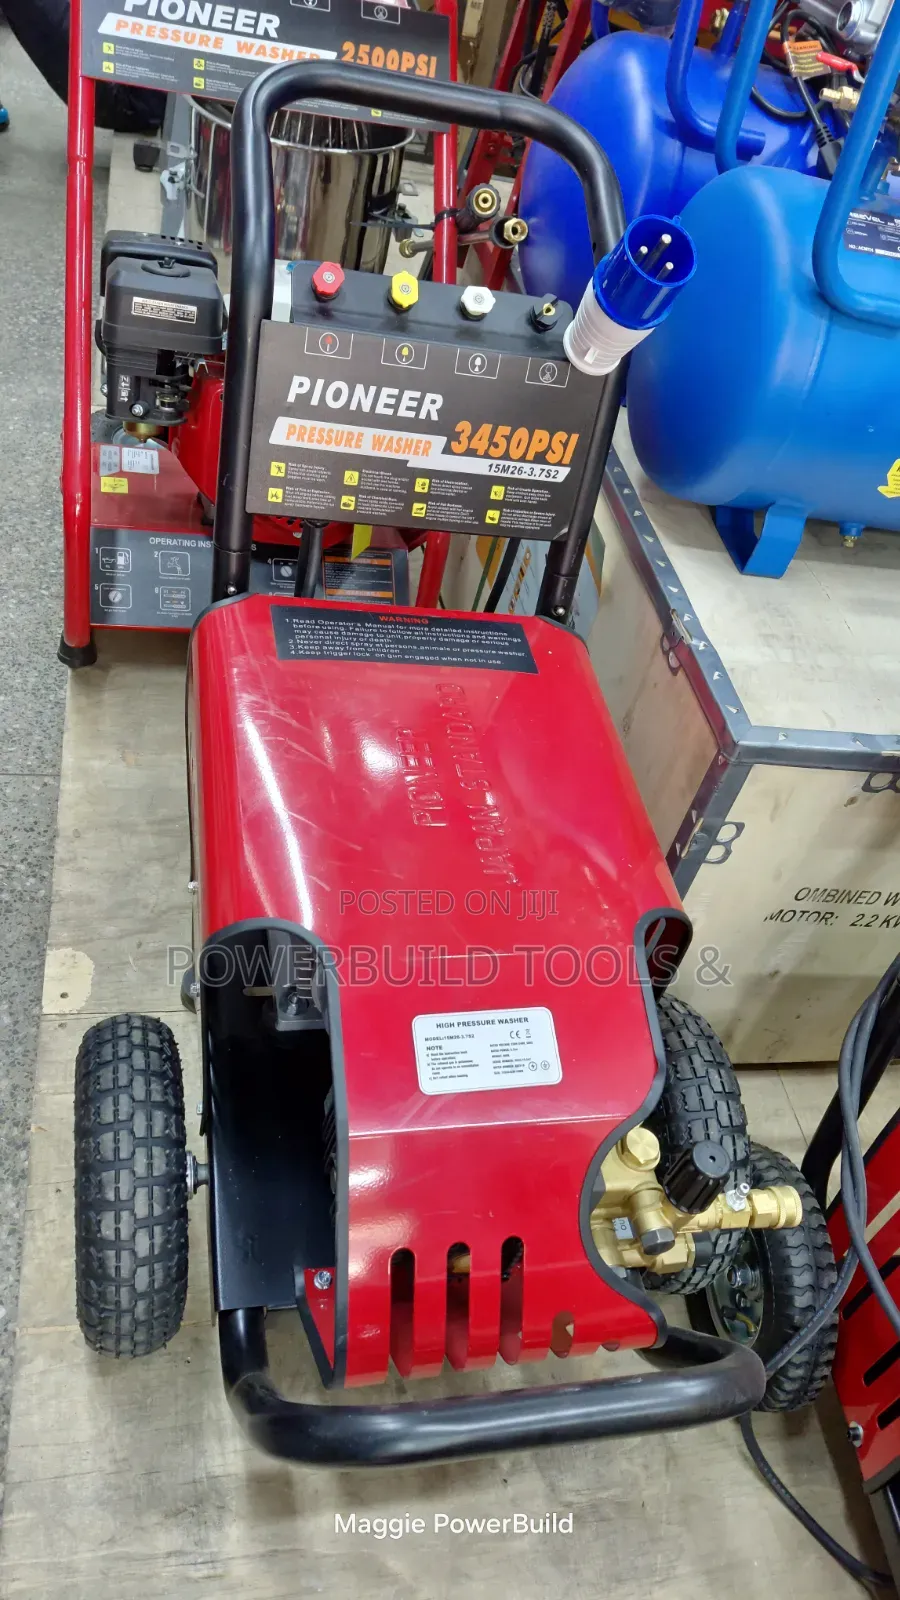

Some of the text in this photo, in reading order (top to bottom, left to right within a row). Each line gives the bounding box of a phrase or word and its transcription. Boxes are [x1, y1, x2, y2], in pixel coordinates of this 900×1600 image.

[115, 19, 224, 50] PRESSURE
[341, 40, 437, 78] 2500PSI
[286, 375, 444, 421] PIONEER
[286, 423, 432, 458] PRESSURE WASHER
[450, 420, 580, 465] 3450PSI
[488, 463, 560, 480] 15M26-3.7S2
[149, 537, 196, 548] OPERATING
[379, 616, 429, 624] WARNING
[396, 726, 448, 827] PIONEER
[436, 683, 521, 886] JAPAN STANDARD
[763, 908, 839, 926] MOTOR:
[849, 913, 880, 928] 2.2
[457, 1019, 496, 1028] PRESSURE
[498, 1017, 529, 1025] WASHER
